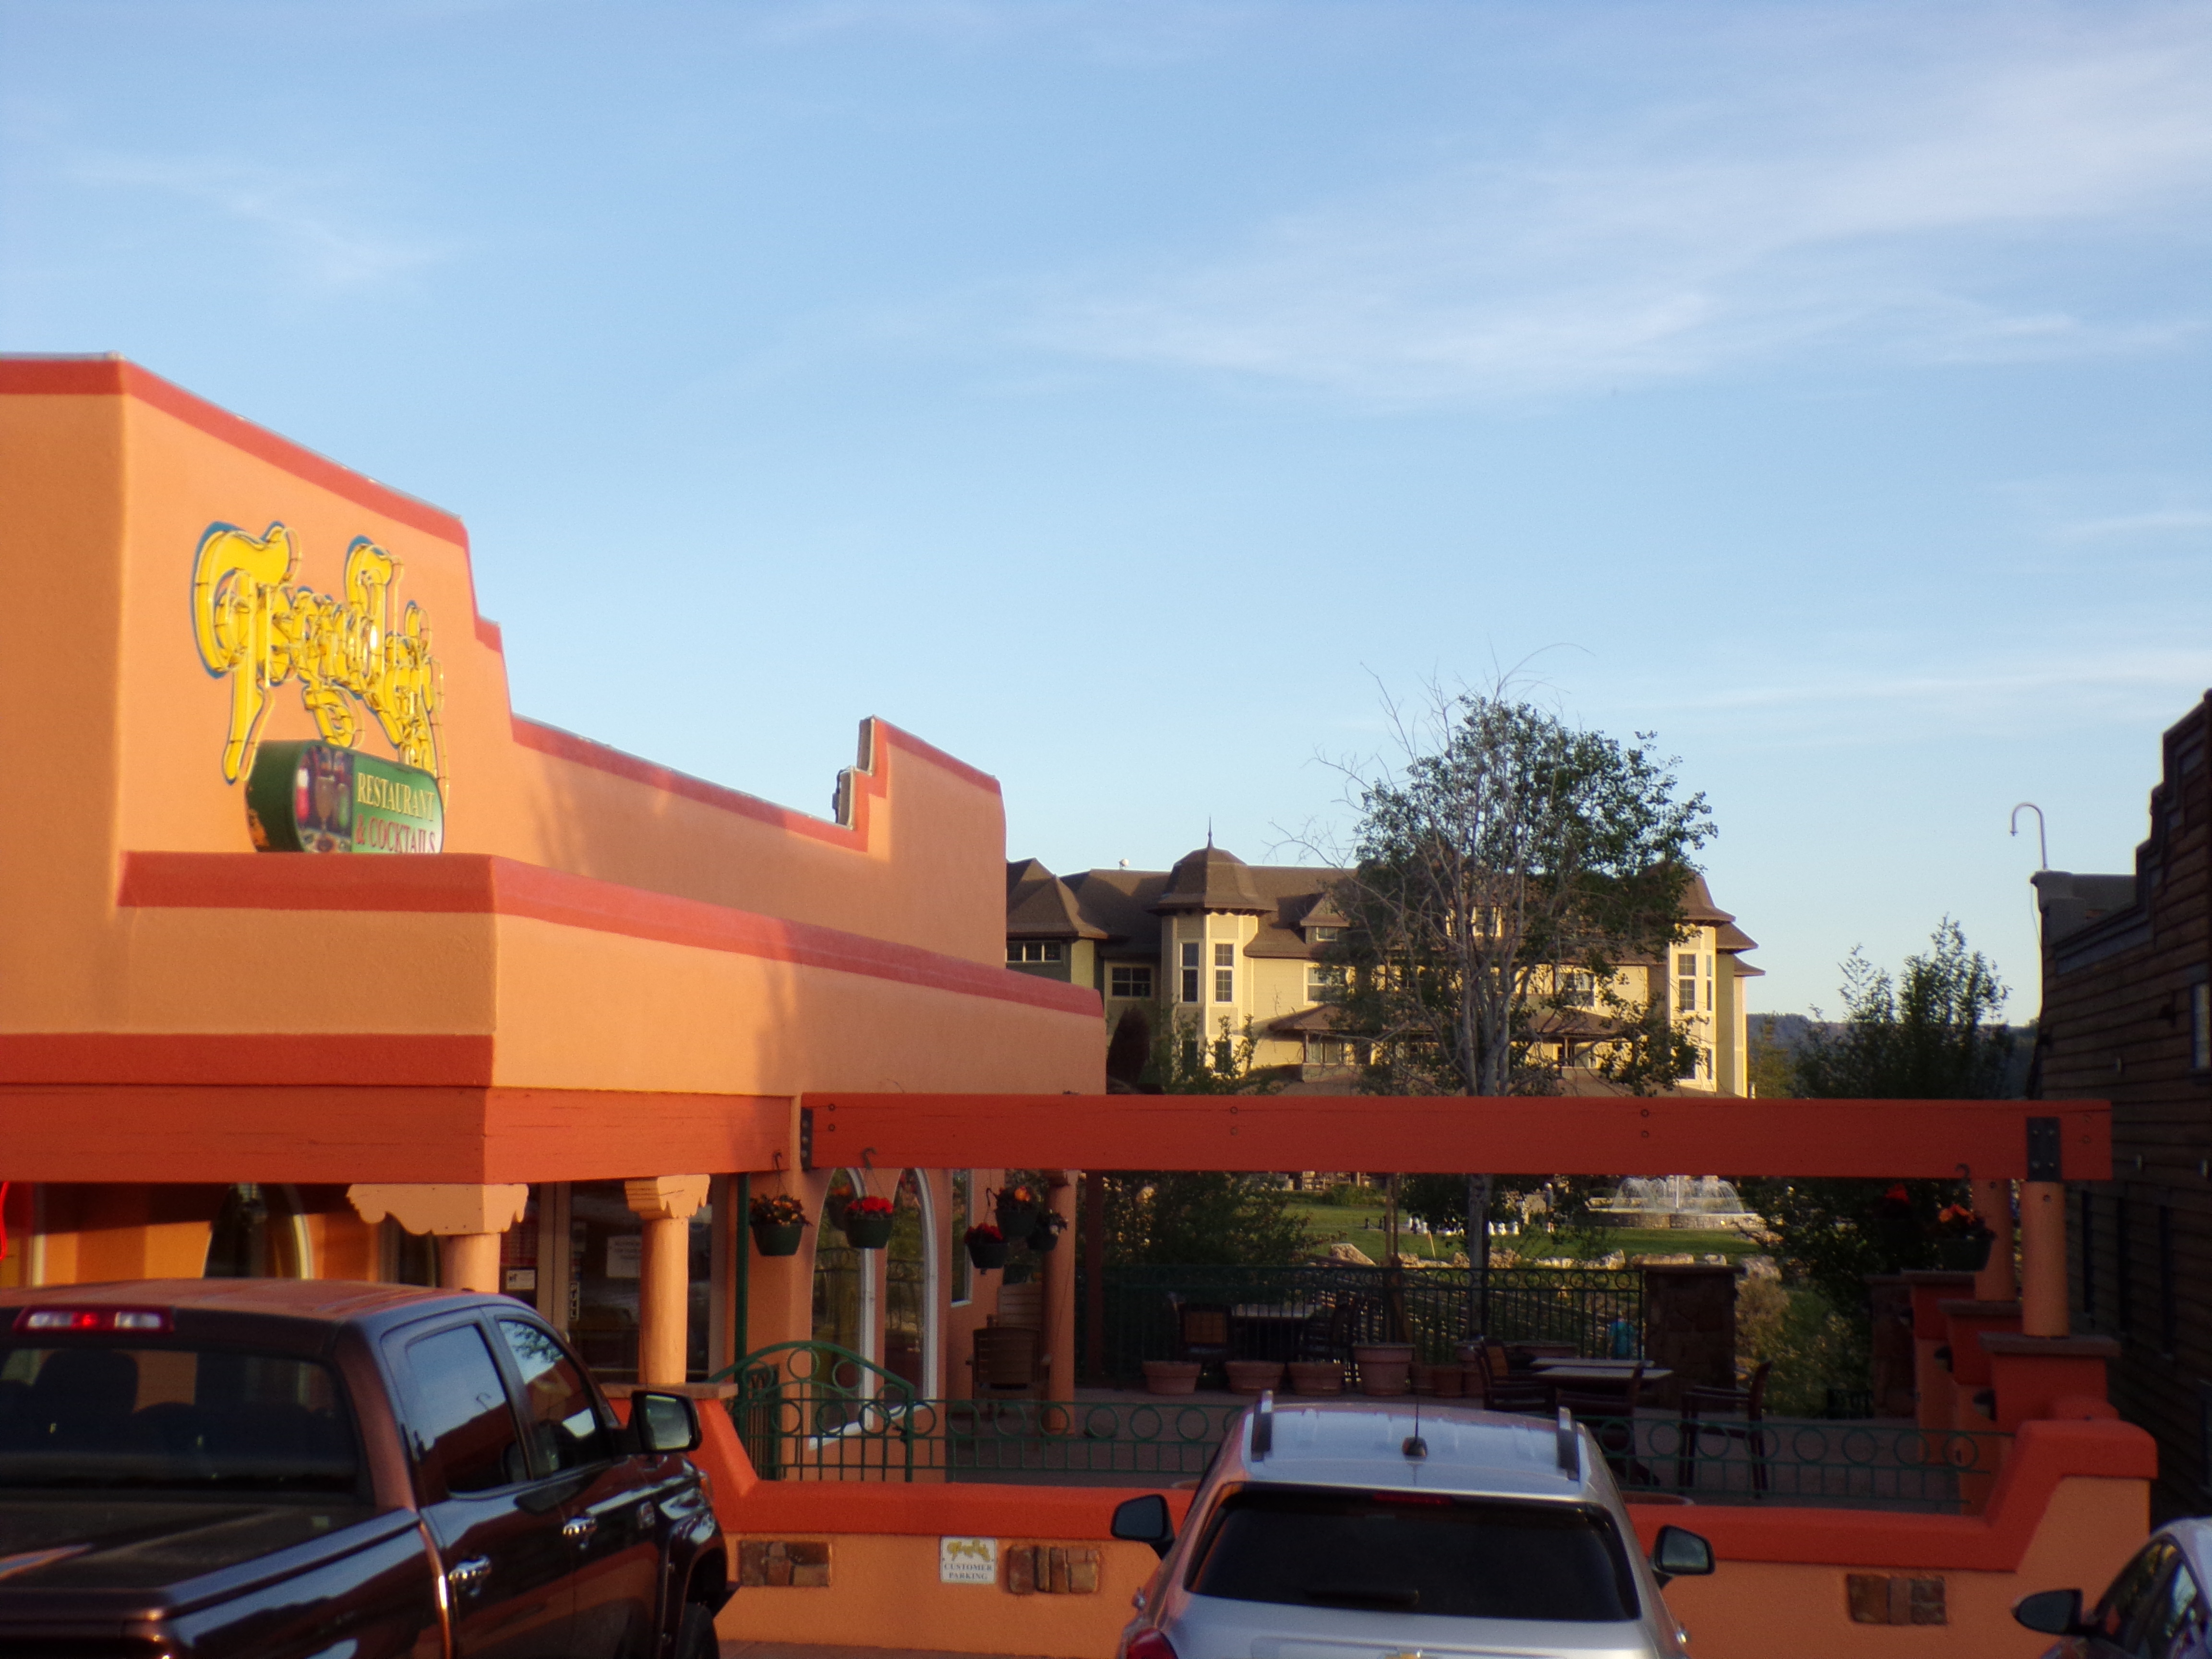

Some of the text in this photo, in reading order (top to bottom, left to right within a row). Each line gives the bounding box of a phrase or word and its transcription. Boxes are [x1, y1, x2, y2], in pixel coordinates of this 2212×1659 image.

[357, 772, 435, 822] RESTAURANT
[354, 814, 435, 854] & COCKTAILS
